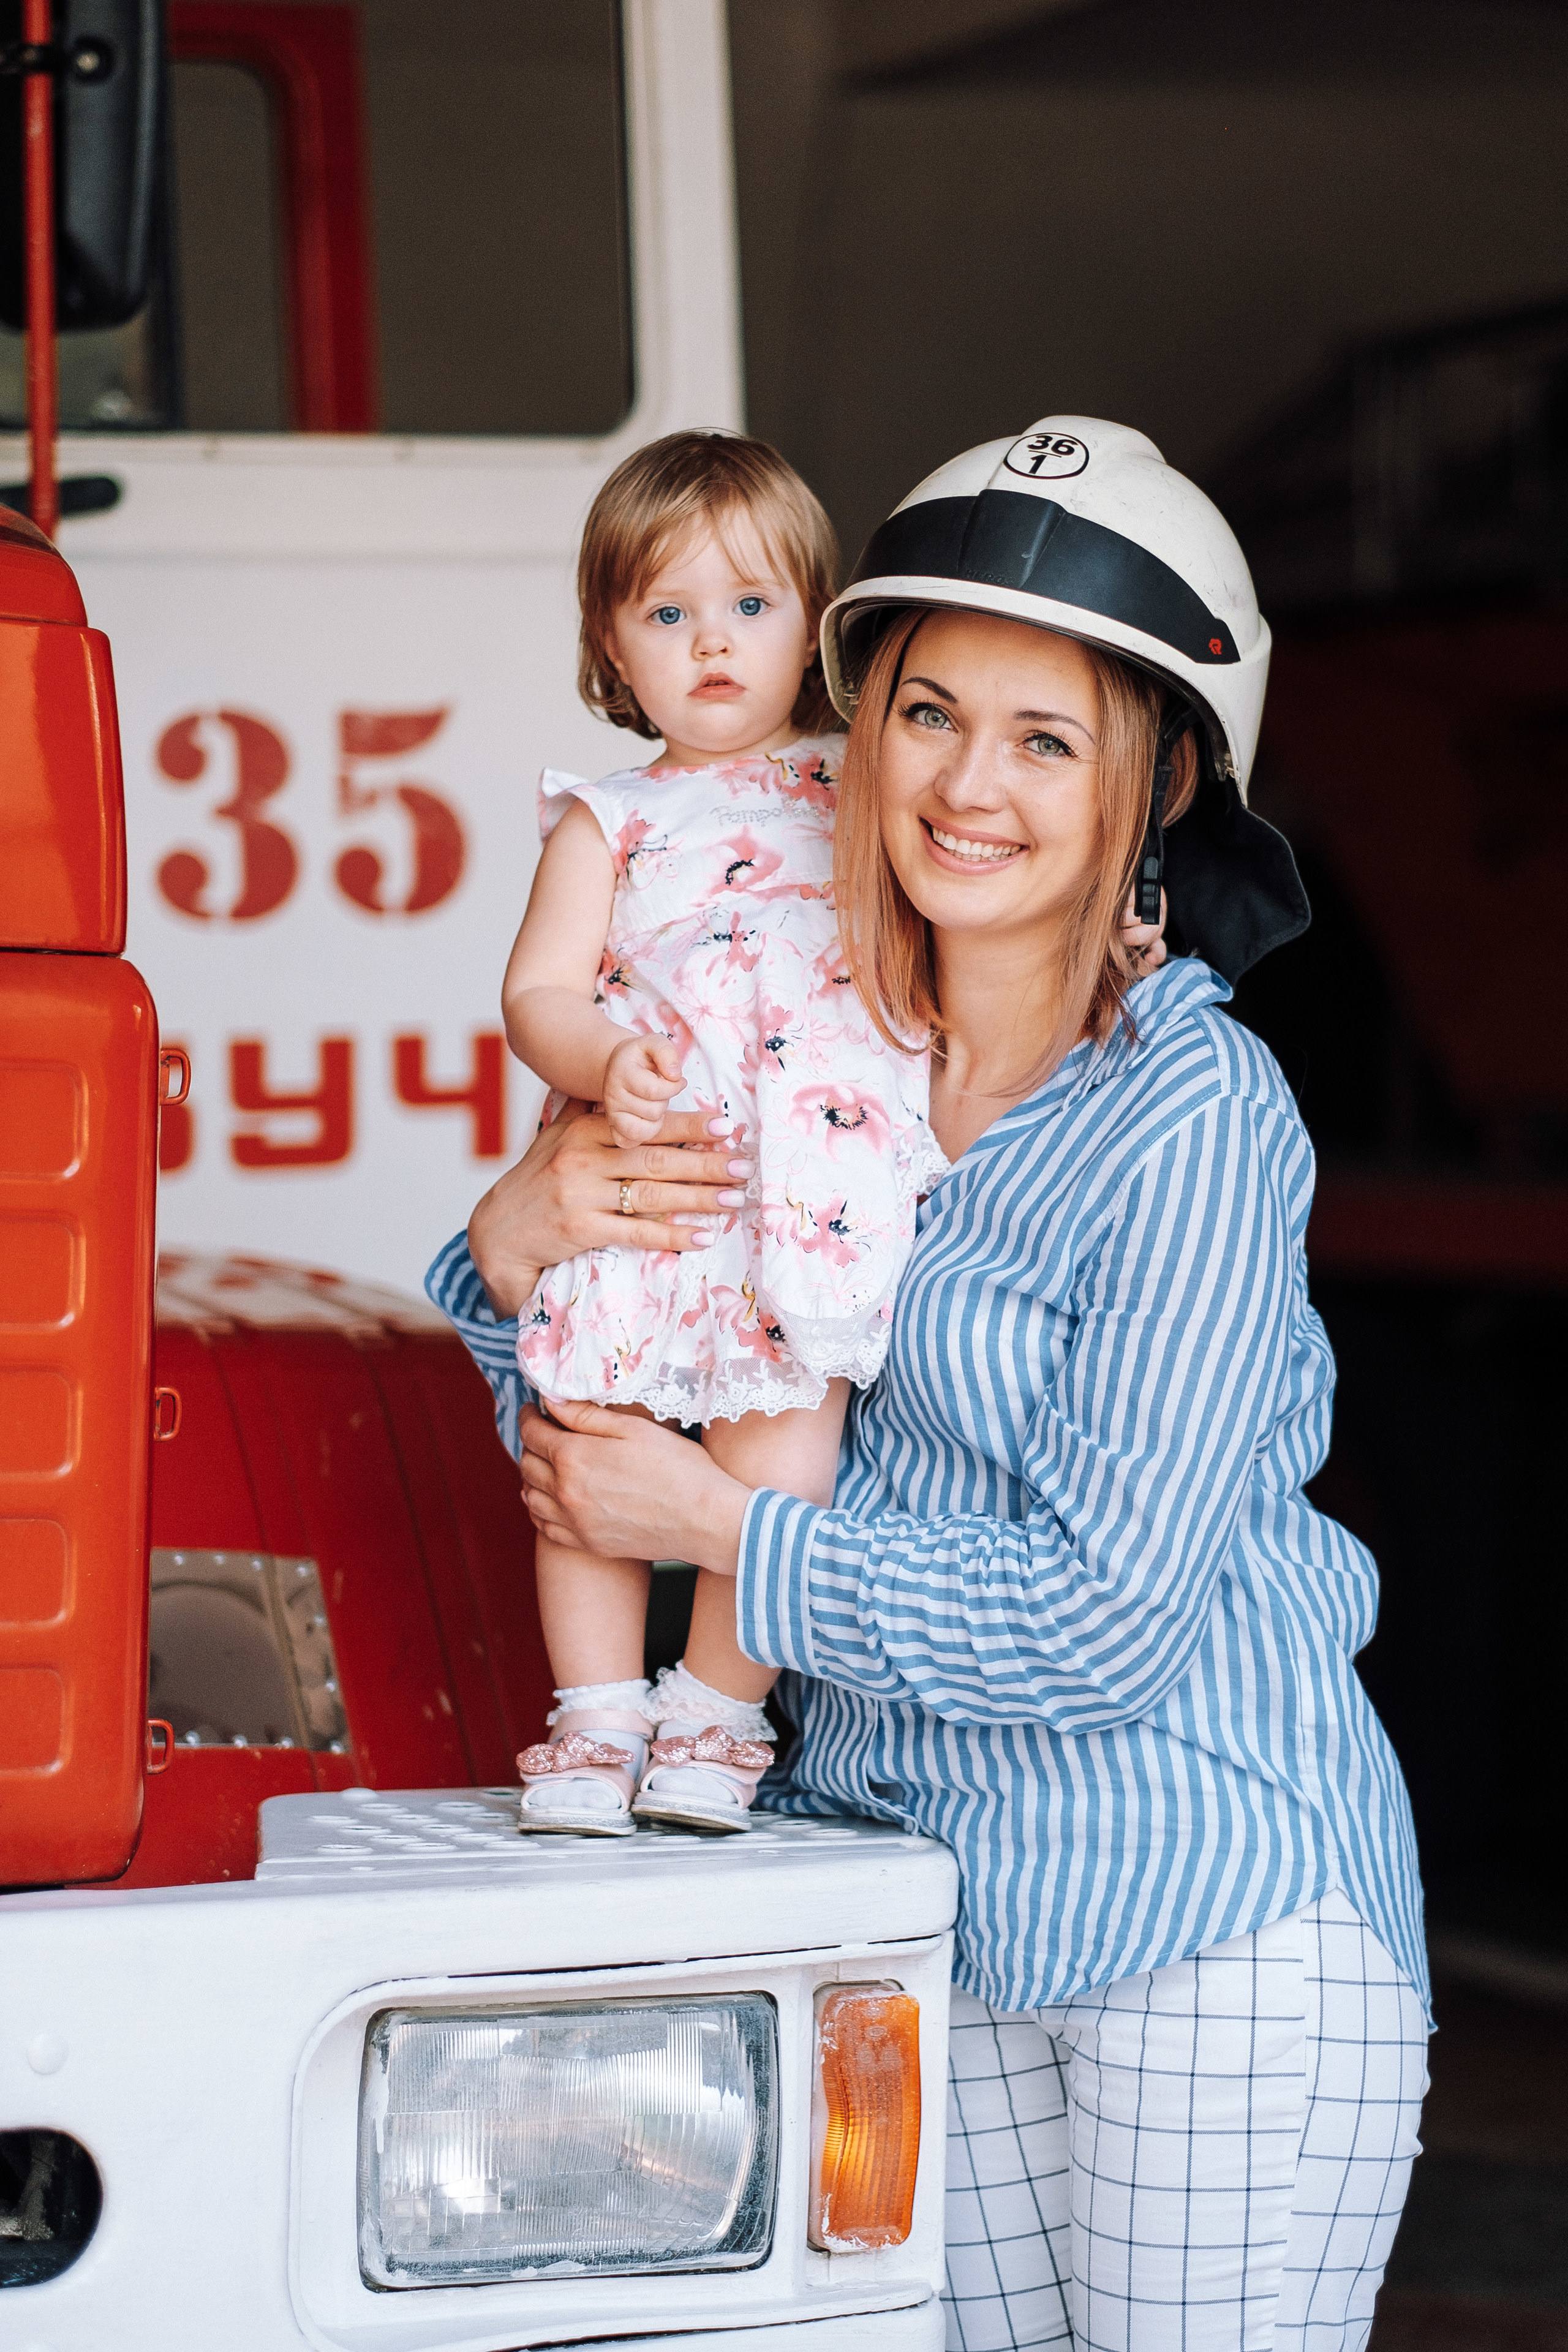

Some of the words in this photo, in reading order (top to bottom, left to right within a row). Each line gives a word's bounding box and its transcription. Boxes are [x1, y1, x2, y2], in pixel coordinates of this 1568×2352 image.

[1027, 435, 1079, 456] 36
[1028, 454, 1047, 475] 1
[155, 706, 470, 922] 35
